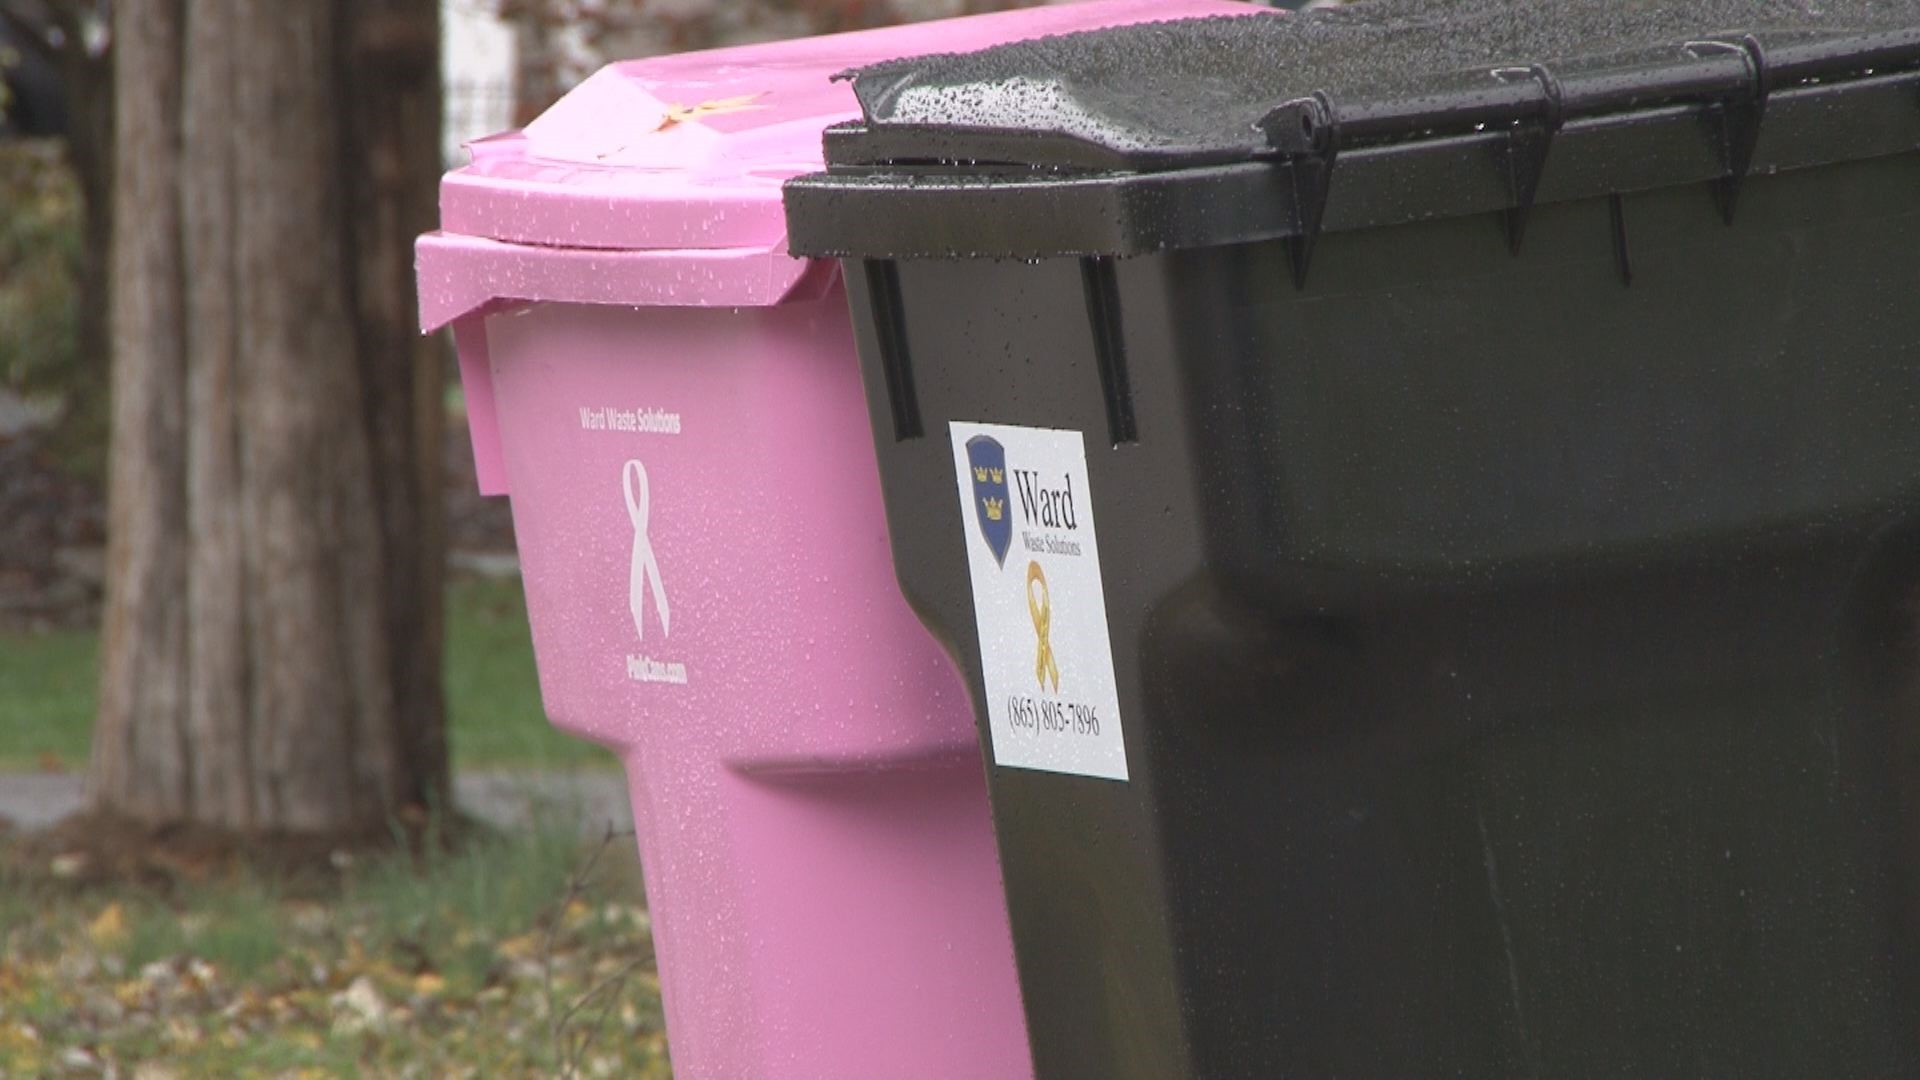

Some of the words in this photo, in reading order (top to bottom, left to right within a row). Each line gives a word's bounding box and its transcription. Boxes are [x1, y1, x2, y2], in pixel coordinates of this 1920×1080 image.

[579, 407, 605, 430] Ward
[605, 407, 636, 432] Waste
[636, 407, 681, 435] Solutions
[1013, 469, 1077, 530] Ward
[1022, 531, 1045, 553] Waste
[1046, 534, 1081, 556] Solutions
[1008, 695, 1040, 736] (865)
[1041, 700, 1100, 736] 805-7896
